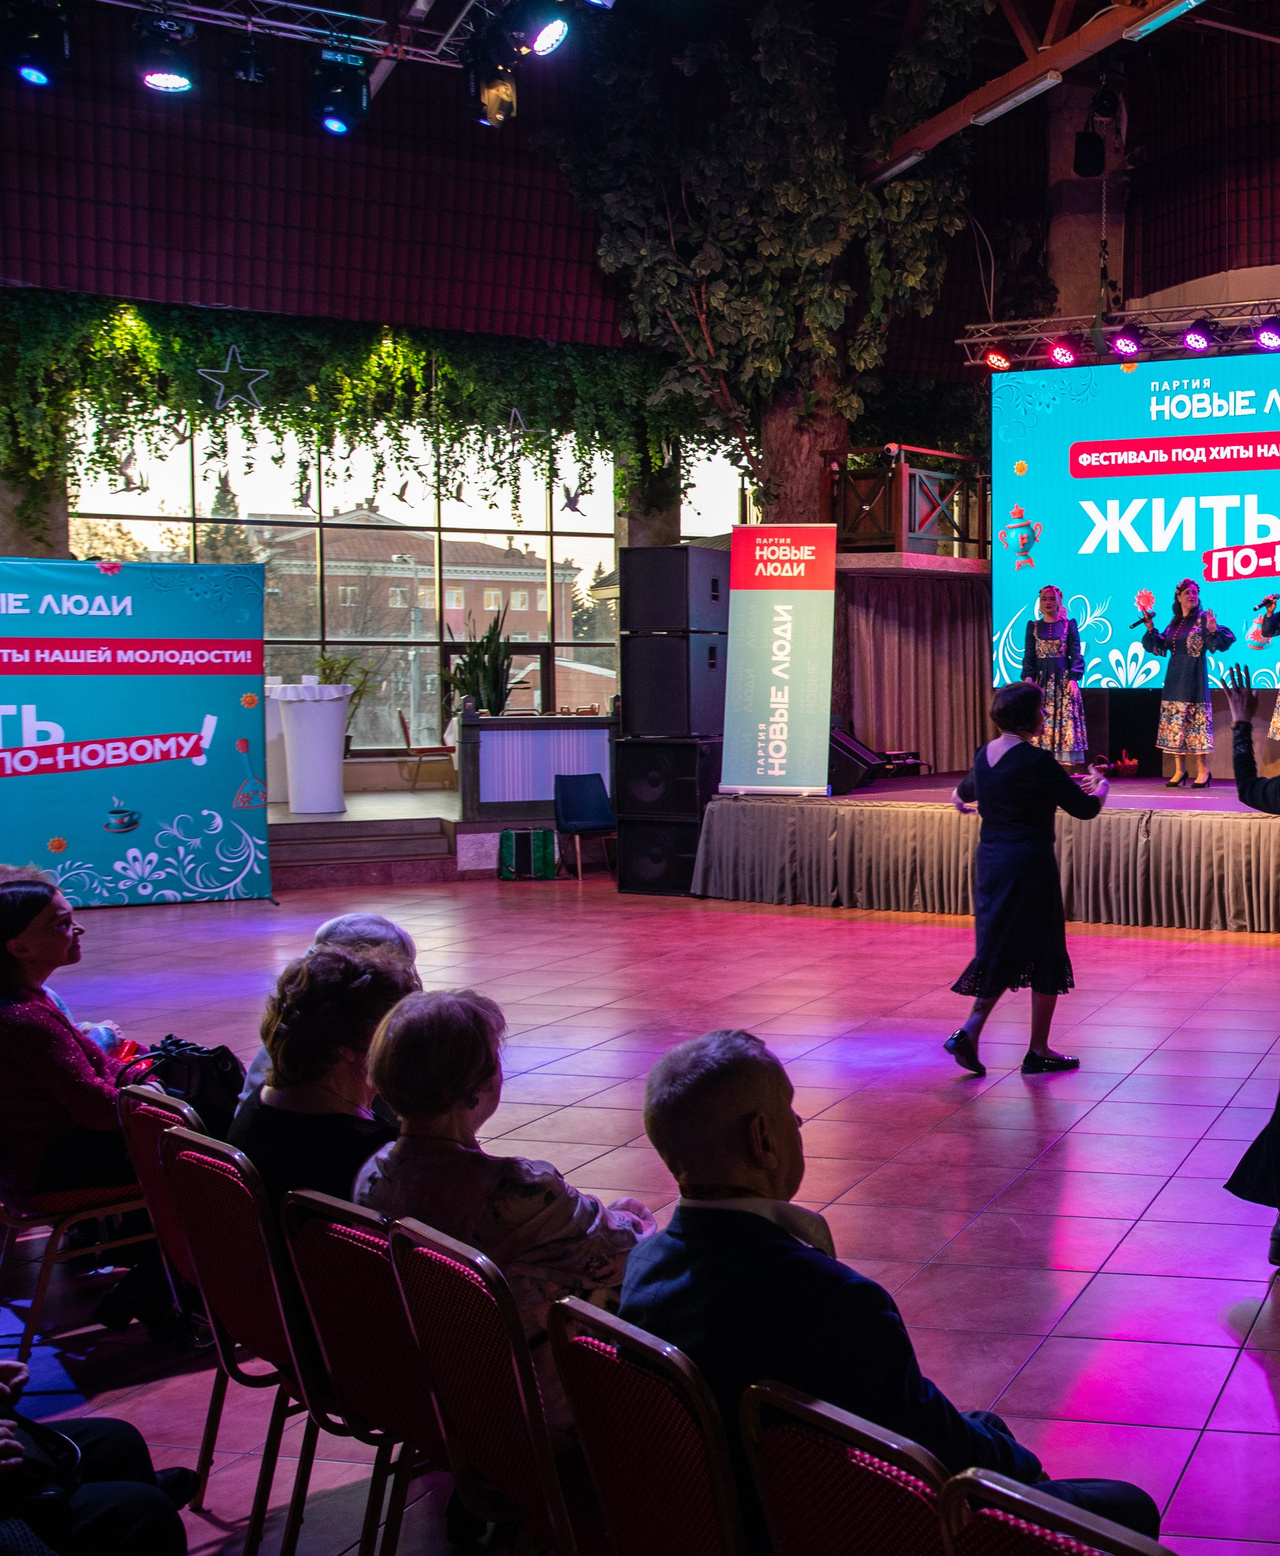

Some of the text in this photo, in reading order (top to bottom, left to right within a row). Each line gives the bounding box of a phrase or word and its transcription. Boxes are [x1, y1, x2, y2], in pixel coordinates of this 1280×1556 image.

[1151, 378, 1211, 391] ПАРТИЯ
[1150, 390, 1256, 421] НОВЫЕ
[1078, 449, 1169, 466] ФЕСТИВАЛЬ
[1171, 447, 1207, 463] ПОД
[1209, 445, 1253, 460] ХИТЫ
[754, 546, 816, 561] НОВЫЕ
[754, 562, 805, 577] ЛЮДИ
[38, 594, 133, 616] ЛЮДИ
[2, 647, 252, 665] ТЫ НАШЕЙ МОЛОДОСТИ!
[768, 604, 793, 776] НОВЫЕ ЛЮДИ
[756, 723, 767, 775] ПАРТИЯ
